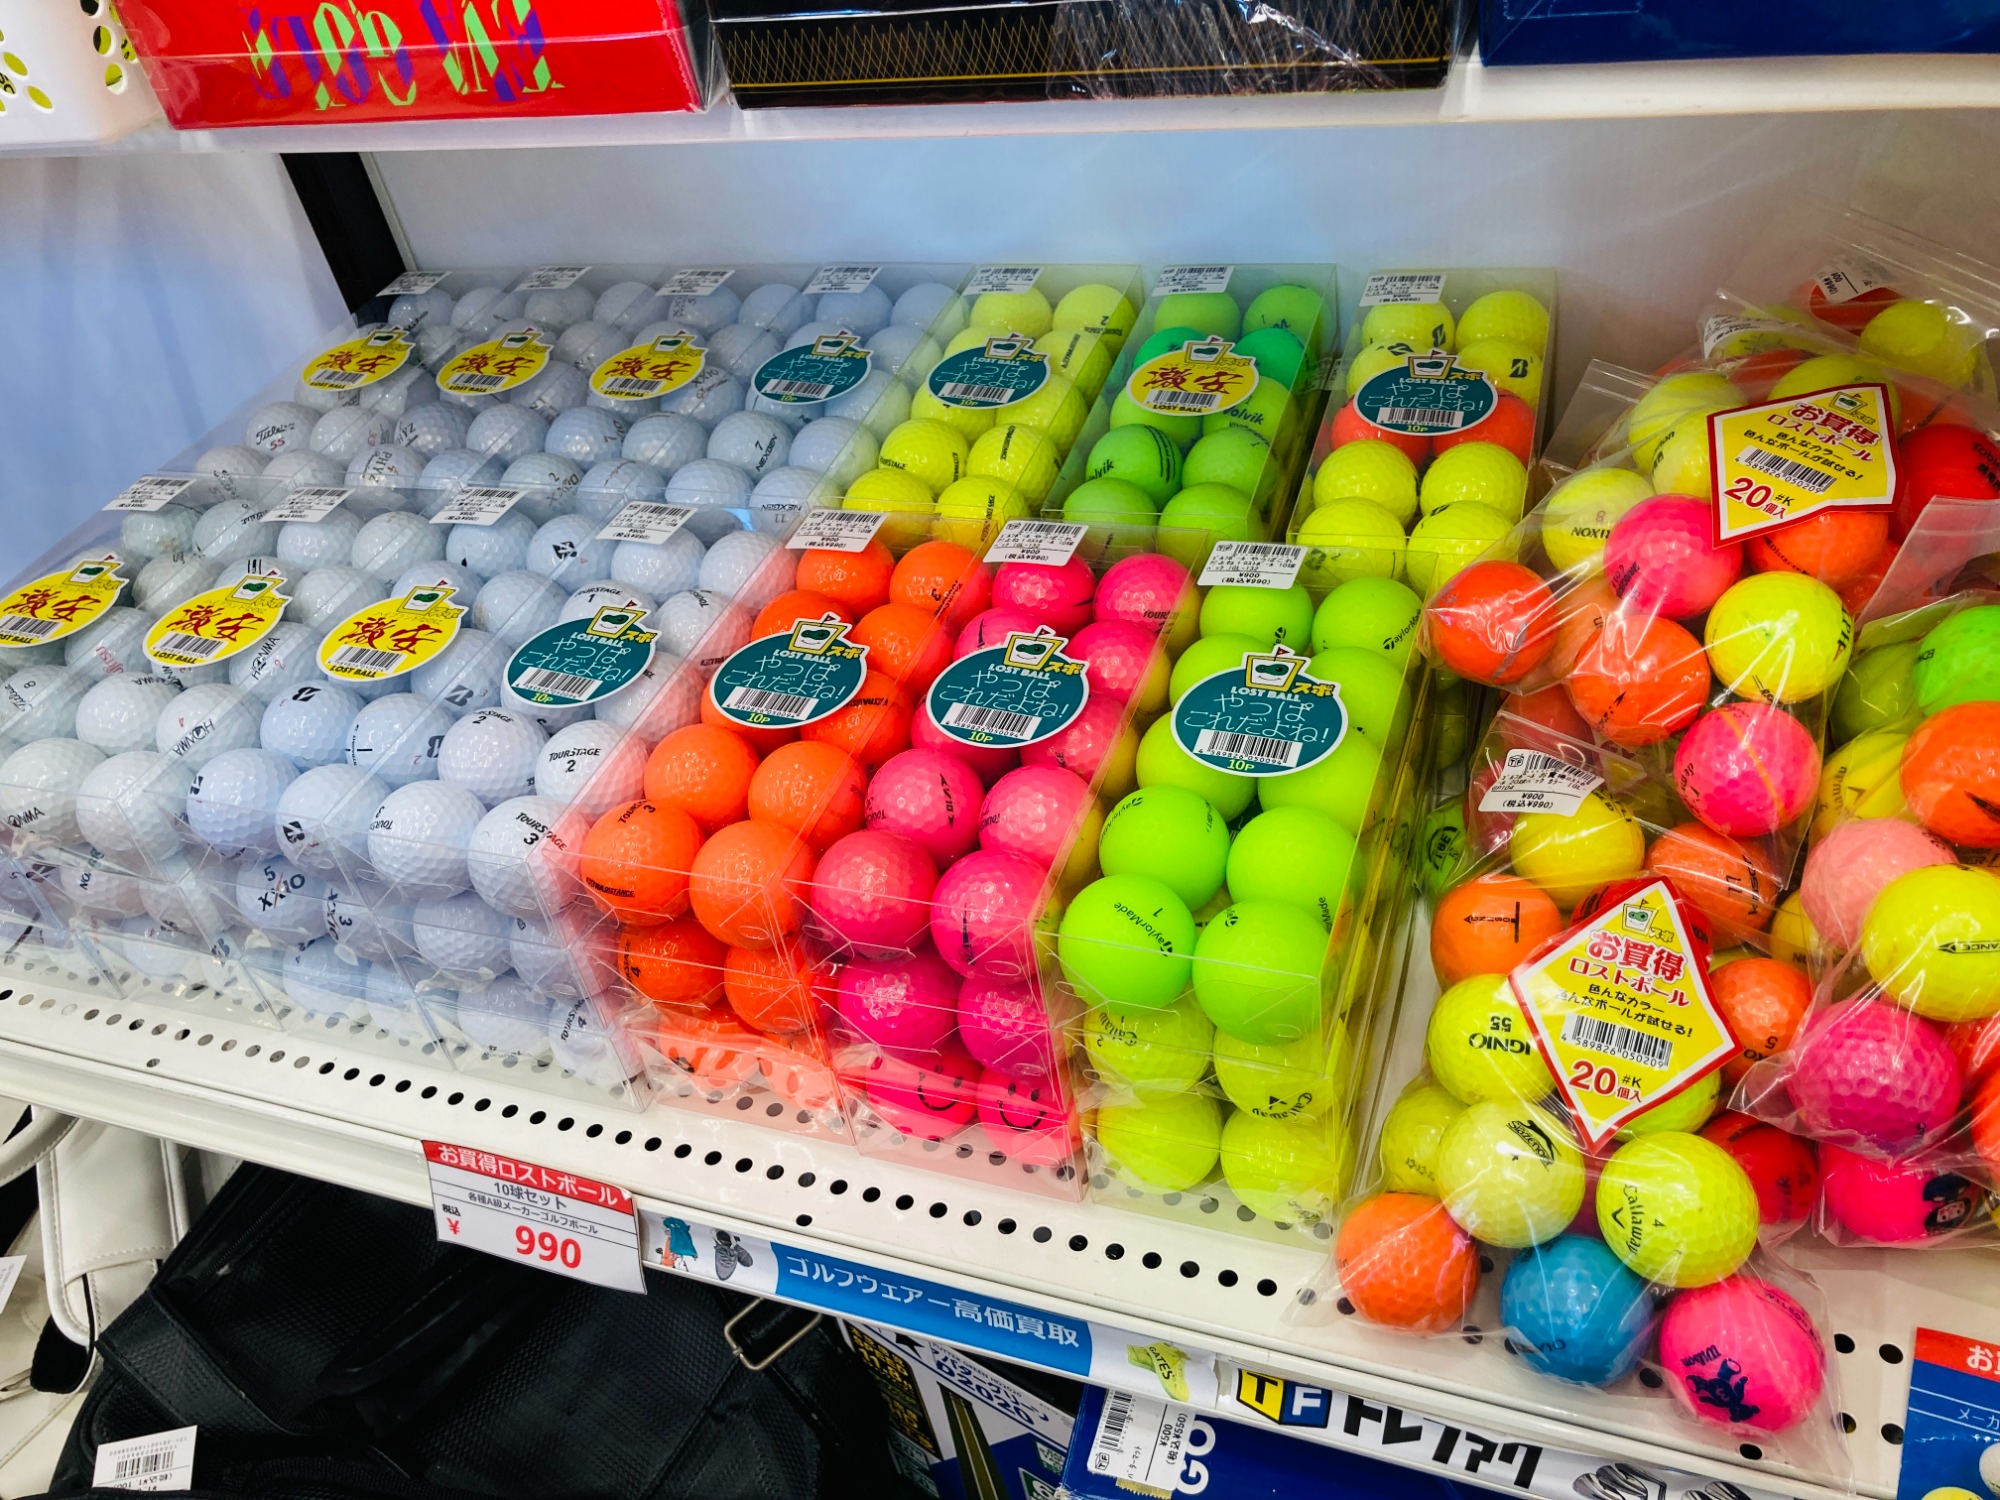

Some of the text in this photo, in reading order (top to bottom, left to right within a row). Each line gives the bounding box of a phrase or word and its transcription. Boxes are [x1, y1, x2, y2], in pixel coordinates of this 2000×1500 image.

[998, 358, 1021, 366] BALL
[1143, 367, 1245, 394] 激安
[1399, 377, 1457, 386] LOST BALL
[1790, 403, 1881, 446] お買得
[1767, 414, 1874, 462] ロストボール
[755, 434, 778, 472] NEXGEN
[368, 451, 392, 484] PHYZ
[1724, 478, 1772, 508] 20
[1763, 502, 1788, 519] 個入
[1571, 526, 1612, 539] RIXON
[166, 604, 265, 642] 激安
[338, 617, 443, 655] 激安
[571, 632, 623, 648] LOST BALL
[153, 651, 198, 664] LOST BALL
[773, 649, 832, 664] LOST BALL
[329, 664, 377, 678] LOST BALL
[988, 664, 1051, 680] LOST BALL
[24, 681, 36, 690] 8
[1230, 686, 1301, 702] LOST BALL
[172, 718, 216, 757] HONMA
[549, 747, 601, 762] TOURSTAGE
[565, 760, 576, 773] 2
[644, 803, 656, 814] 3
[515, 811, 568, 851] TOURSTAGE
[523, 832, 539, 846] 3
[264, 865, 276, 882] 5
[339, 916, 353, 927] 3
[1152, 907, 1163, 918] 1
[1113, 902, 1173, 957] TaylorMade
[1589, 932, 1688, 982] お買得
[630, 966, 641, 978] 4
[1569, 958, 1691, 1008] ロストボール
[577, 1015, 588, 1029] 4
[1490, 1015, 1513, 1032] 55
[1468, 1031, 1532, 1055] IGNIO
[1764, 1035, 1778, 1050] 5
[1569, 1060, 1642, 1096] 20 #K
[1616, 1087, 1642, 1103] 個入
[1507, 1119, 1554, 1168] Slazenger
[439, 1144, 618, 1206] お買得ロストボール
[494, 1181, 567, 1210] 10球セット
[442, 1203, 461, 1217] 税込
[468, 1192, 598, 1235] 各種A級メーカーゴルフボール
[1624, 1183, 1645, 1255] Callaway
[1652, 1217, 1665, 1228] 4
[447, 1217, 581, 1269] ¥ 990
[1681, 1344, 1722, 1368] Wilson
[1159, 1423, 1174, 1448] ¥500
[1166, 1412, 1188, 1466] (税込¥550)
[1343, 1395, 1543, 1489] トレファク
